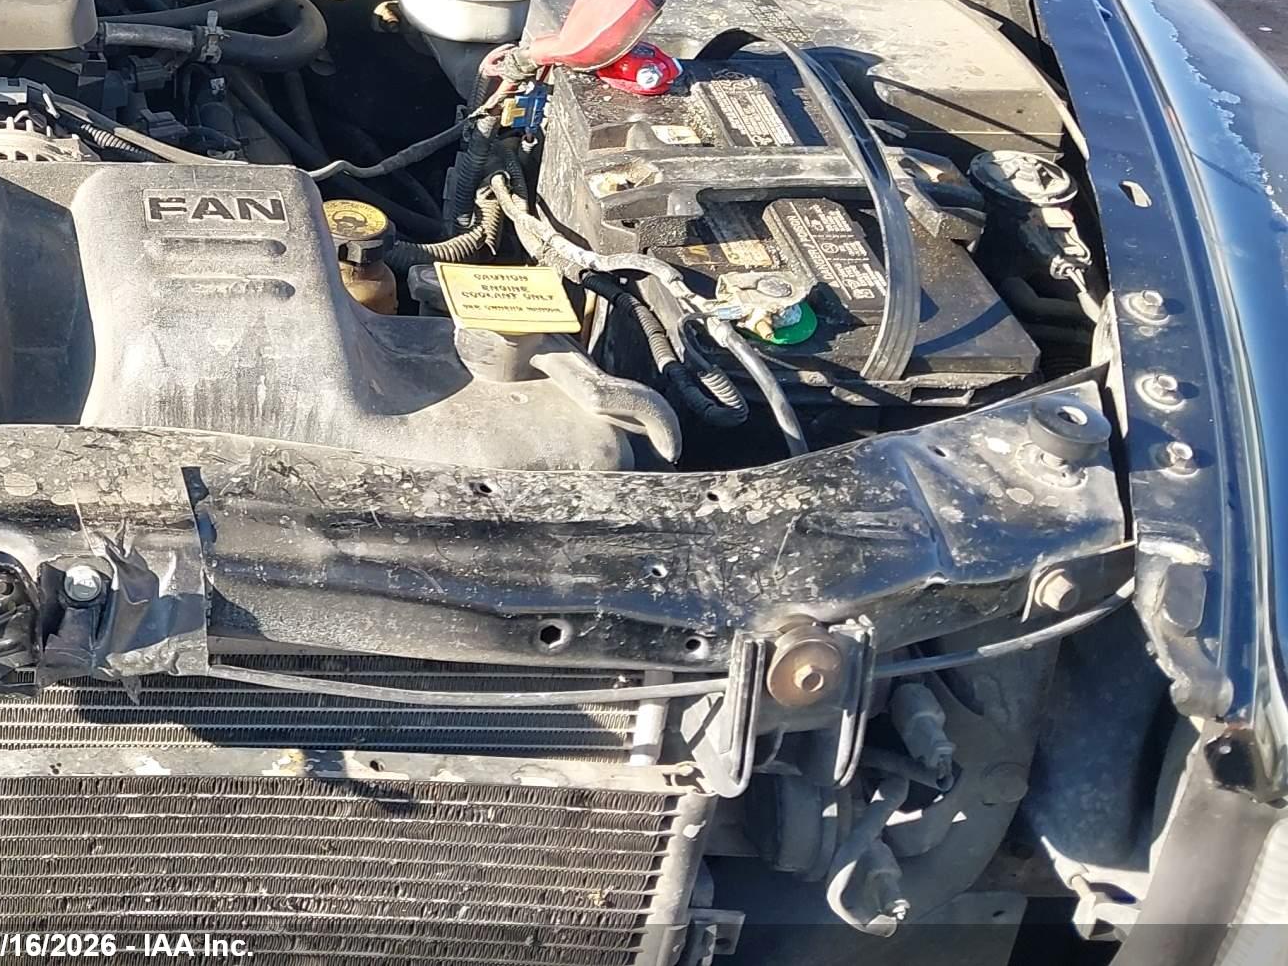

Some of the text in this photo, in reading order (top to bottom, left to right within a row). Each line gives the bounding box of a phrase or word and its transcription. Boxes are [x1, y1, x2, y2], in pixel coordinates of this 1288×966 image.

[148, 194, 285, 224] FAN
[473, 273, 528, 282] CAUTION
[480, 284, 530, 293] ENGINE
[461, 291, 554, 301] COOLANT ONLY
